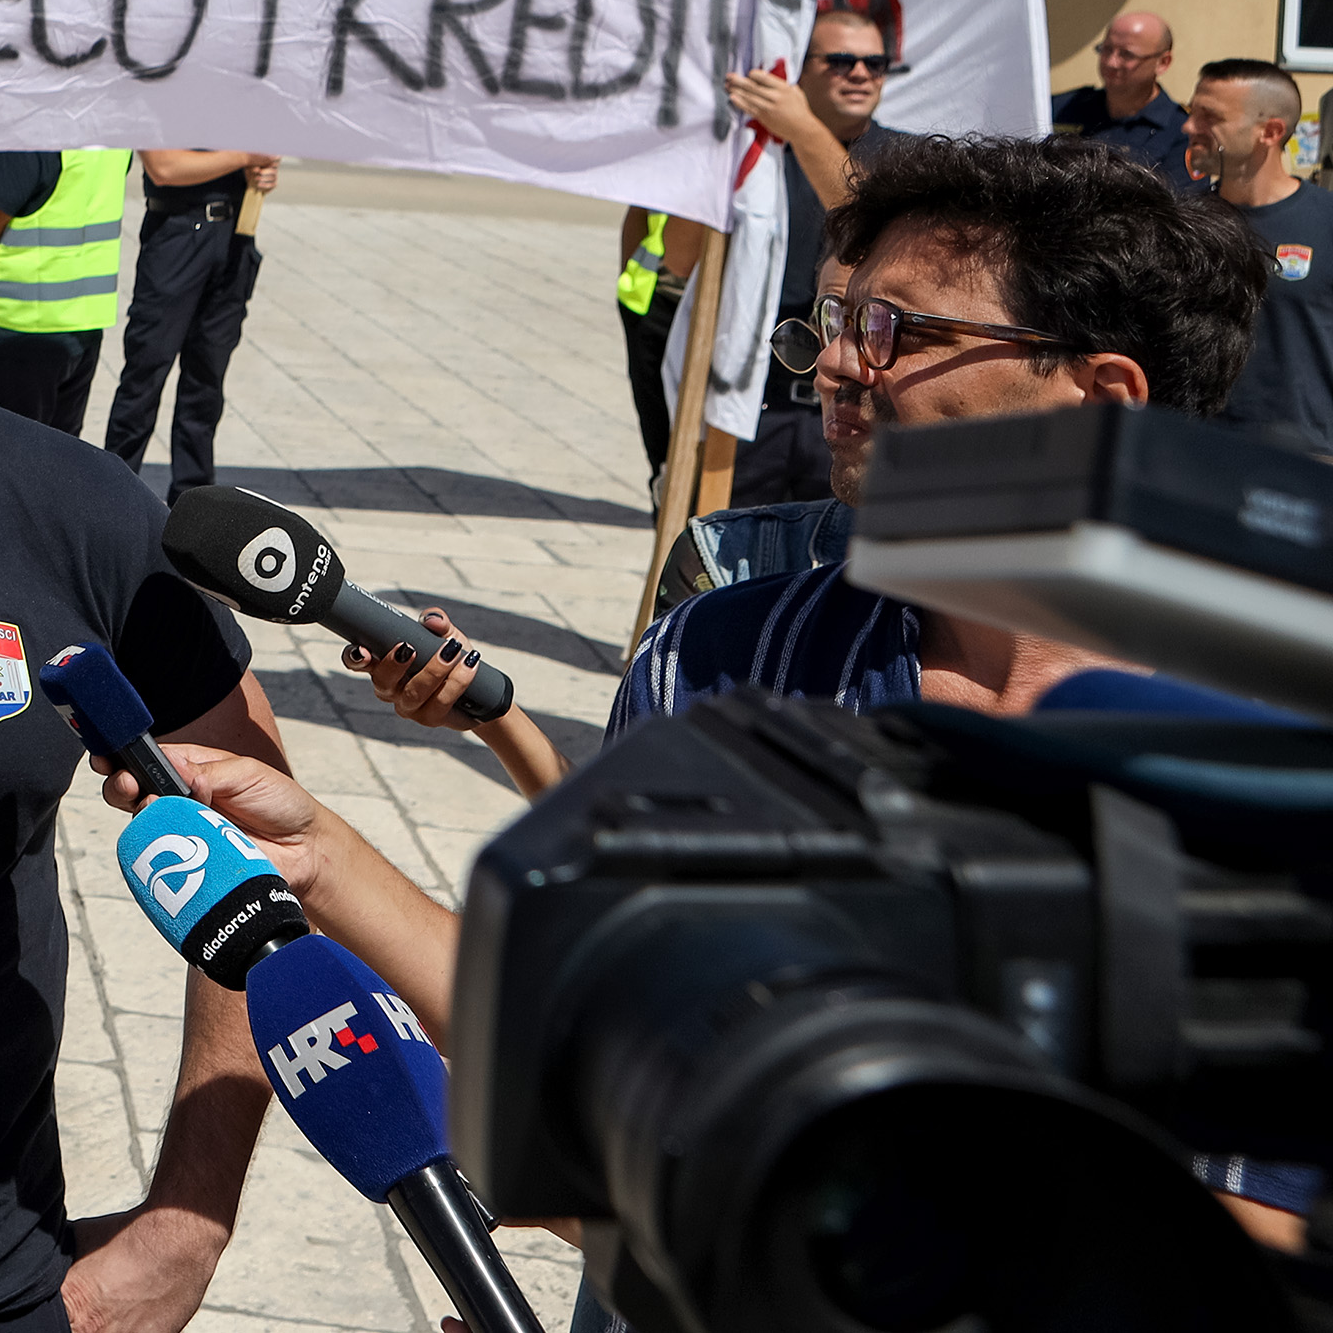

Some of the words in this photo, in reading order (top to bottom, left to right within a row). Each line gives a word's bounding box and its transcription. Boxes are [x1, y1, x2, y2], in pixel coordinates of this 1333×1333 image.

[288, 544, 328, 616] antena
[202, 900, 262, 961] diadora.tv
[267, 1000, 379, 1100] HRT
[370, 992, 434, 1048] HR
